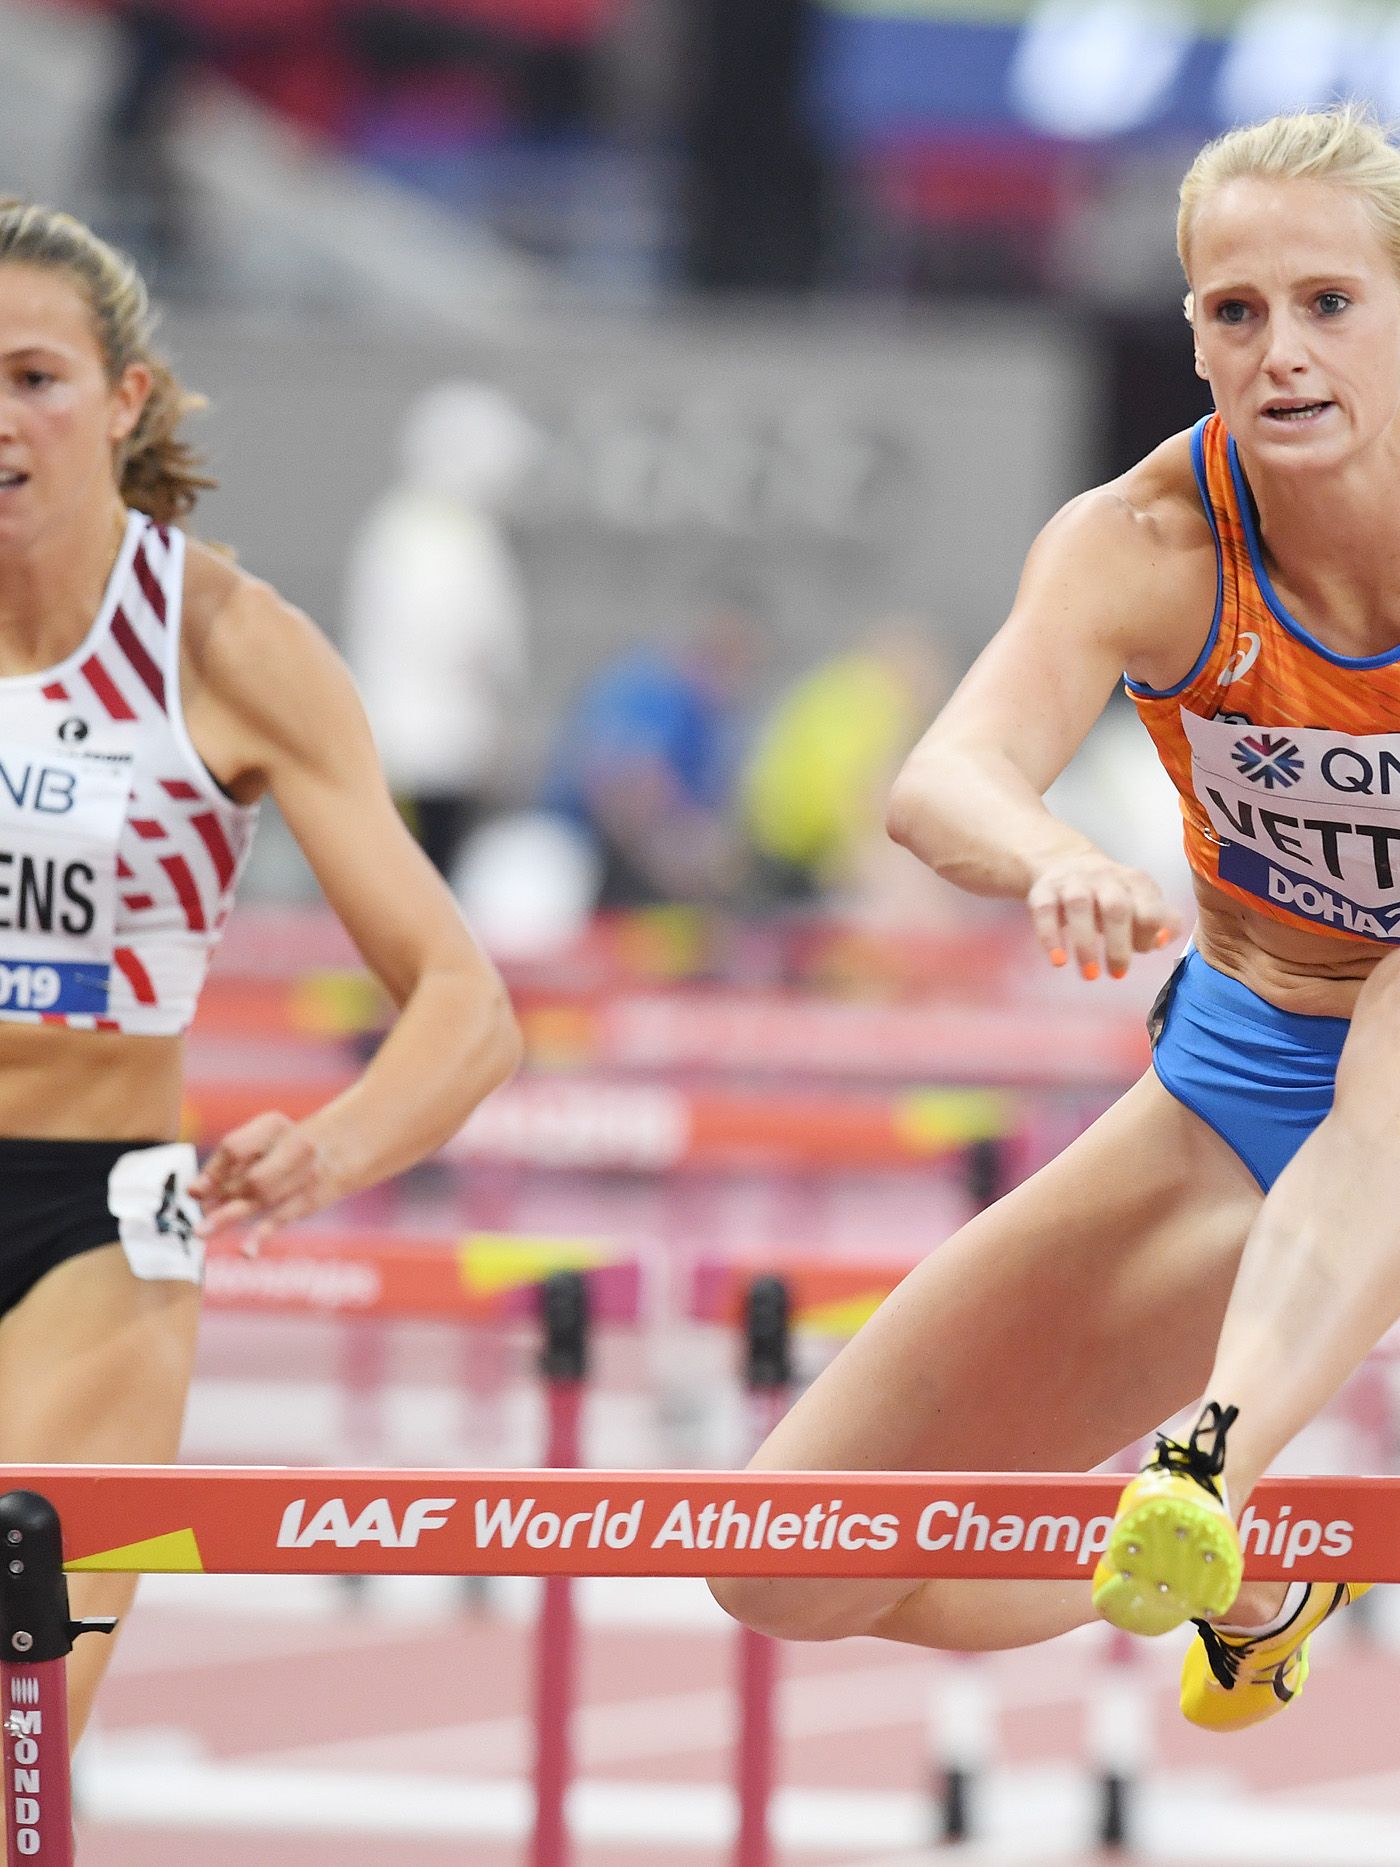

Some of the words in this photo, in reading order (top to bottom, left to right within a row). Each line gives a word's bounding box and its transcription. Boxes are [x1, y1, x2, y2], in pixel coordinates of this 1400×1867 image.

[276, 1498, 457, 1548] IAAF
[475, 1498, 644, 1549] World
[651, 1499, 900, 1550] Athletics
[915, 1500, 1355, 1569] Champhips
[9, 1708, 42, 1855] MONDO
